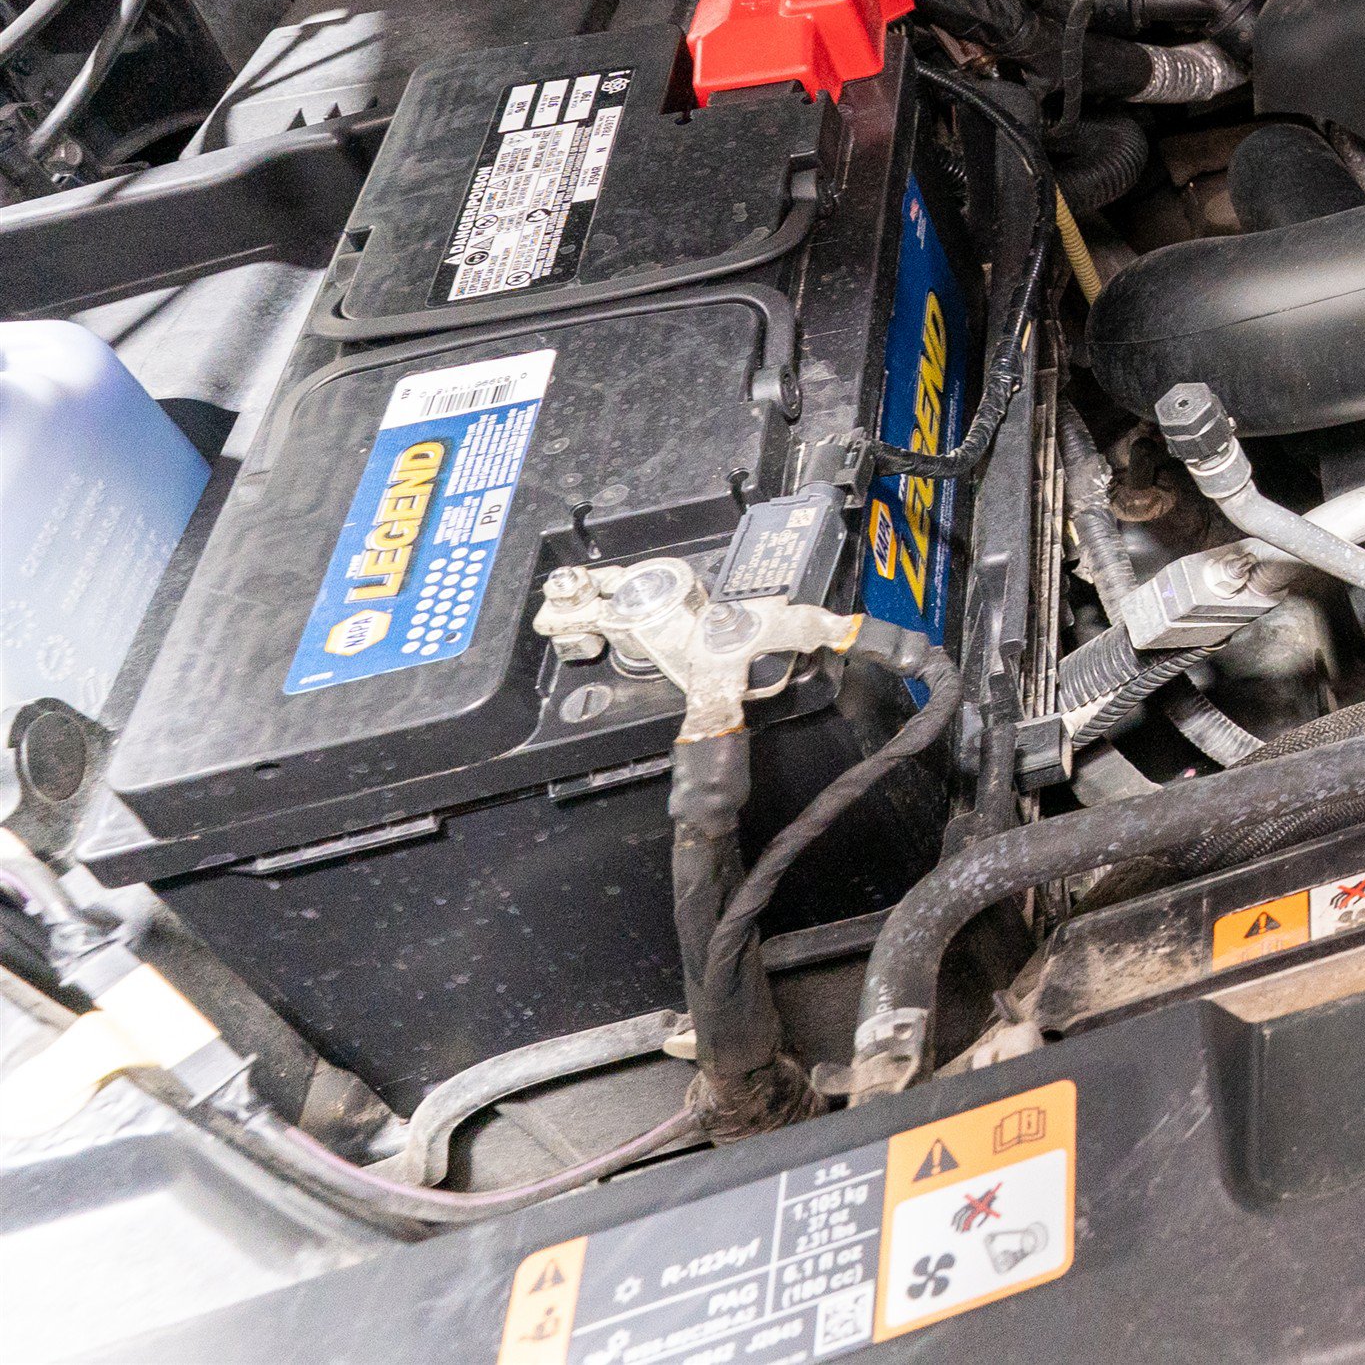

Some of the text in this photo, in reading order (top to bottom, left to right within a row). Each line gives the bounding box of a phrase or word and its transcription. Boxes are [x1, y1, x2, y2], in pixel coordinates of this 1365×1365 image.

[547, 95, 561, 108] 970
[579, 90, 593, 103] 790
[448, 165, 493, 253] DANGER/POISON
[400, 387, 411, 400] 12V
[345, 440, 446, 604] LEGEND
[476, 502, 503, 526] Pb
[875, 511, 891, 569] NAPA
[341, 615, 373, 649] NAPA
[707, 1283, 758, 1317] PAG
